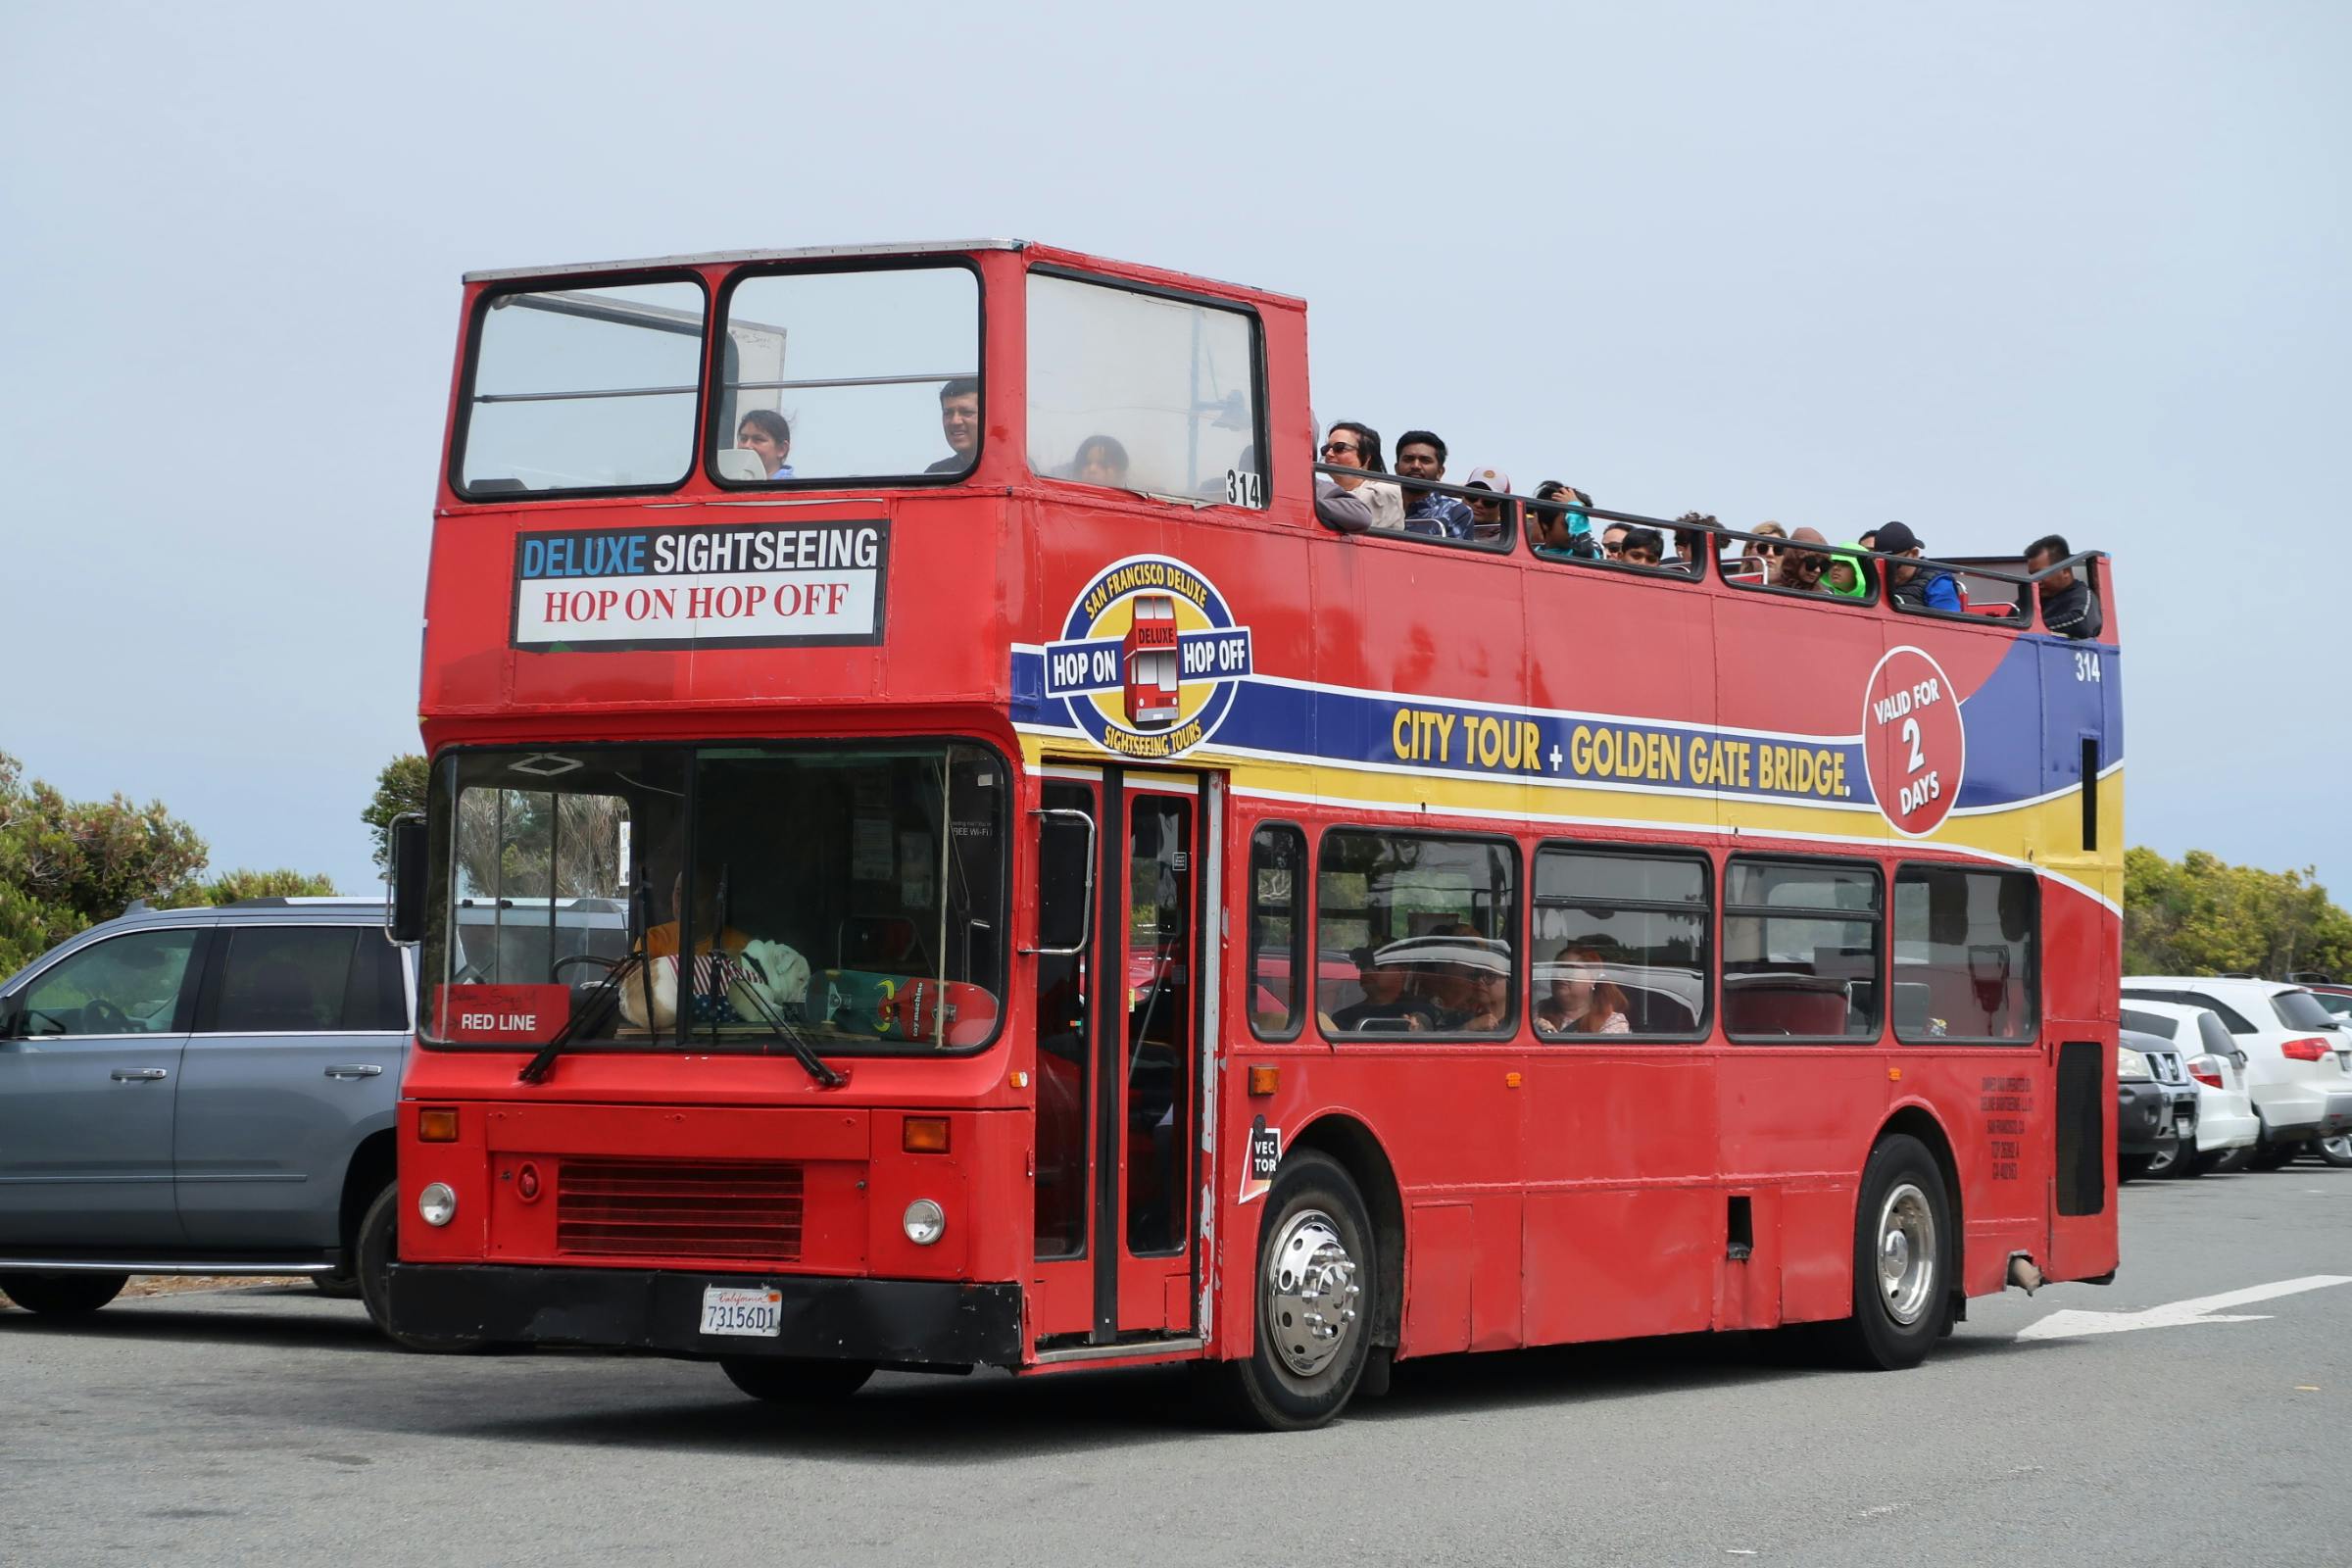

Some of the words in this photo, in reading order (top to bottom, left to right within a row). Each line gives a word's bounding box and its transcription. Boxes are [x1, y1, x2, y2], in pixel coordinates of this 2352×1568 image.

[1227, 468, 1260, 508] 314
[523, 535, 647, 577] DELUXE
[653, 527, 878, 573] SIGHTSEEING
[543, 590, 618, 623] HOP
[624, 588, 678, 621] ON
[686, 585, 767, 619] HOP
[773, 583, 850, 616] OFF
[1084, 587, 1106, 619] SAN
[1105, 564, 1164, 597] FRANCISCO
[1166, 564, 1208, 610] DELUXE
[1138, 627, 1174, 645] DELUXE
[1054, 653, 1089, 687] HOP
[1093, 650, 1117, 683] ON
[1183, 641, 1215, 674] HOP
[1219, 639, 1246, 671] OFF
[2075, 652, 2101, 683] 314
[1873, 690, 1912, 725] VALID
[1913, 677, 1941, 709] FOR
[1103, 724, 1169, 757] SIGHTSEEING
[1171, 718, 1202, 752] TOURS
[1393, 708, 1456, 761] CITY
[1463, 715, 1542, 771] TOUR
[1570, 724, 1681, 782] GOLDEN
[1689, 735, 1751, 788] GATE
[1902, 717, 1926, 773] 2
[1899, 770, 1940, 815] DAYS
[462, 1013, 495, 1030] RED
[499, 1014, 537, 1031] LINE
[1254, 1141, 1275, 1154] VEC
[1254, 1159, 1276, 1172] TOR
[708, 1306, 774, 1328] 73156D1
[719, 1293, 767, 1304] California
